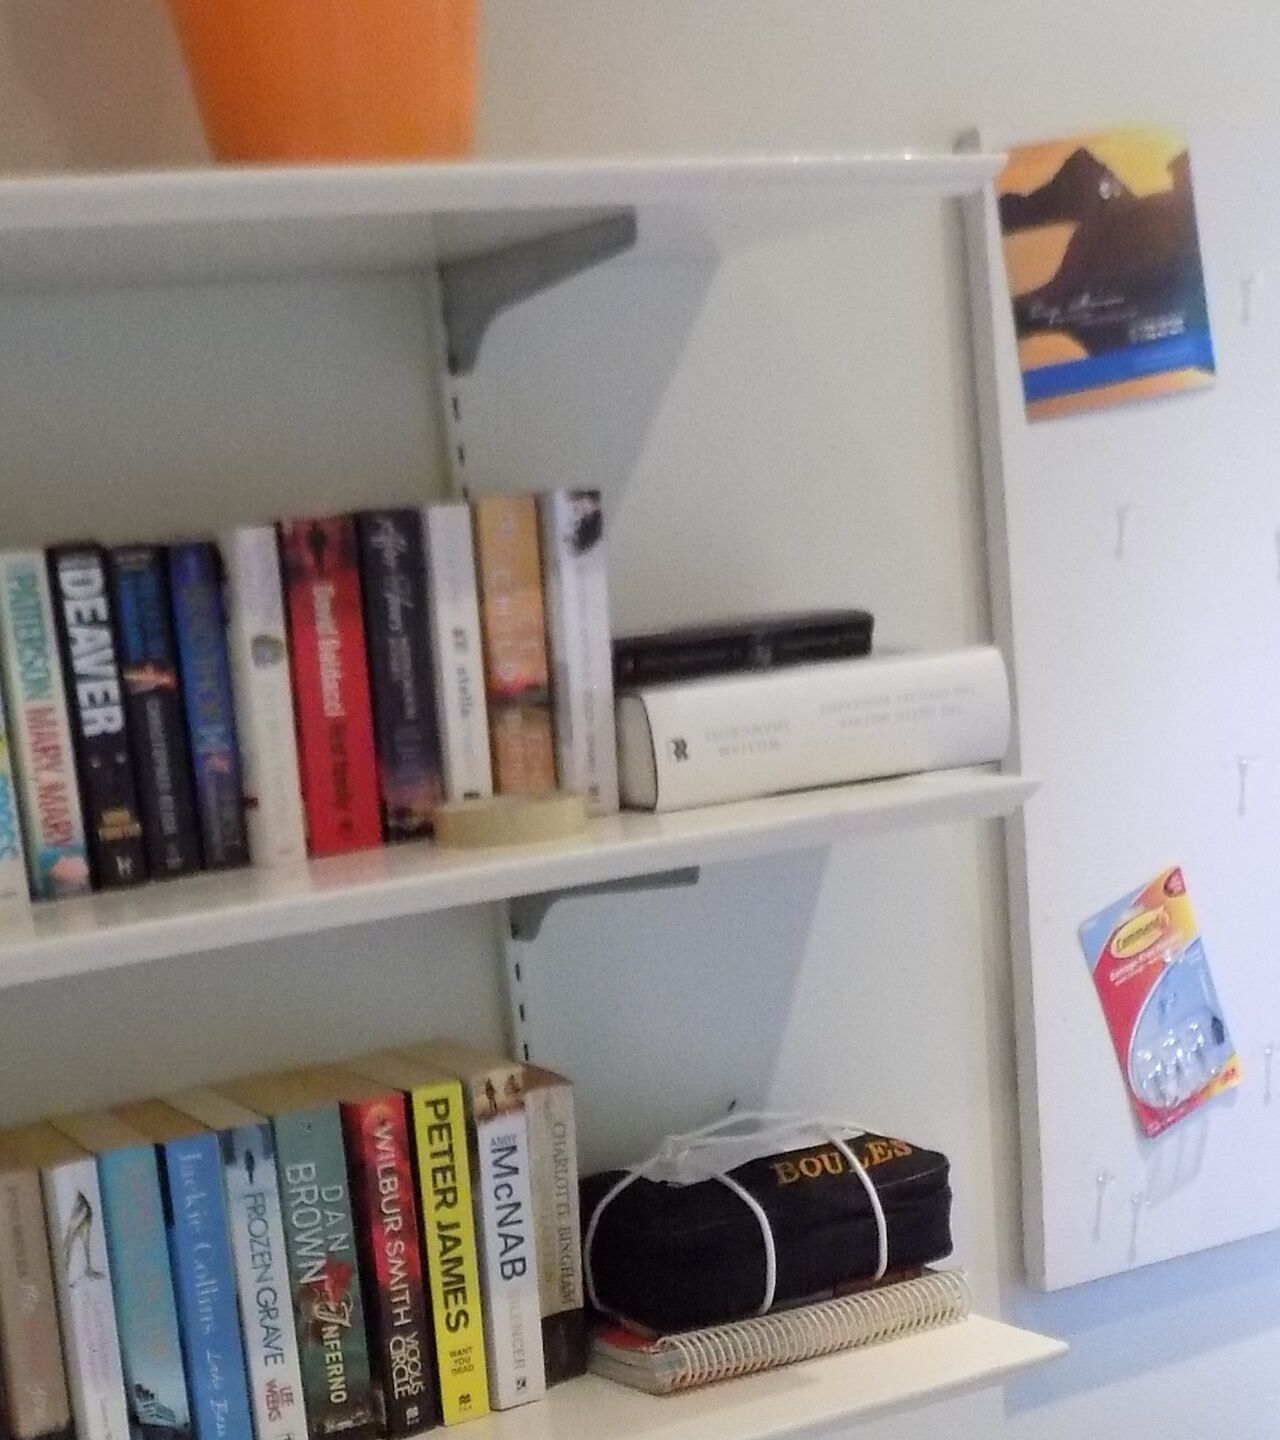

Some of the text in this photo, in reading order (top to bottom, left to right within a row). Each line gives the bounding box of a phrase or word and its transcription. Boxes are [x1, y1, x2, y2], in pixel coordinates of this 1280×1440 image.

[8, 572, 52, 701] PATTERSON
[61, 567, 124, 738] DEAVER
[38, 783, 75, 847] MARY
[489, 1133, 518, 1148] ANDY
[770, 1137, 915, 1187] BOUES
[179, 1149, 218, 1335] Jackie Collins
[284, 1162, 329, 1284] BROWN
[320, 1185, 349, 1252] DAN
[372, 1121, 413, 1326] WILBUR SMITH
[423, 1098, 470, 1334] PETER JAMES
[490, 1145, 526, 1281] McNAB
[549, 1121, 575, 1305] CHARLOTTE BINGHAM
[243, 1191, 284, 1367] FROZEN GRAVE
[279, 1385, 293, 1406] LEE
[313, 1297, 349, 1404] INFERNO
[387, 1335, 410, 1400] CIRCLE
[403, 1331, 423, 1393] VICIOUS
[449, 1346, 474, 1358] WANT
[451, 1364, 475, 1375] DEAD
